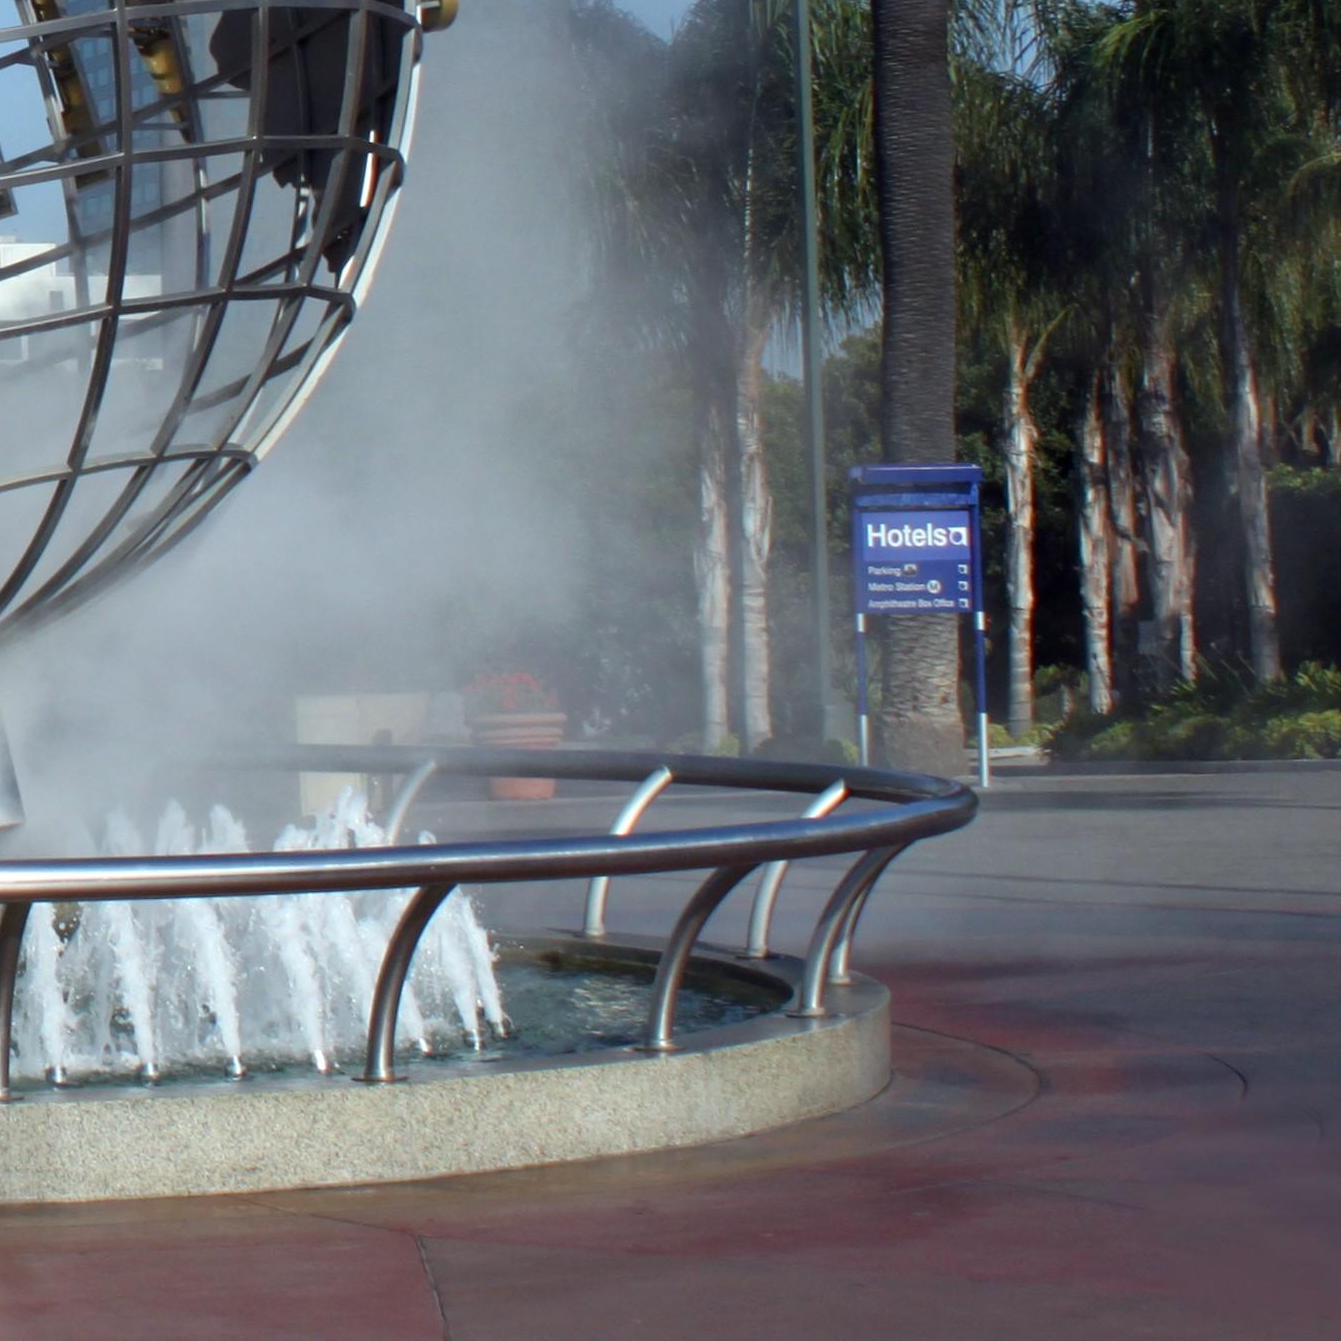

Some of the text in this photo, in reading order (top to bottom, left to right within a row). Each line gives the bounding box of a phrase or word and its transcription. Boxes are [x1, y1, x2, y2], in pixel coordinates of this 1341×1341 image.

[867, 523, 949, 548] Hotels
[868, 565, 902, 577] Parking
[868, 581, 894, 591] Metro
[896, 581, 926, 591] Station
[933, 598, 955, 608] Office
